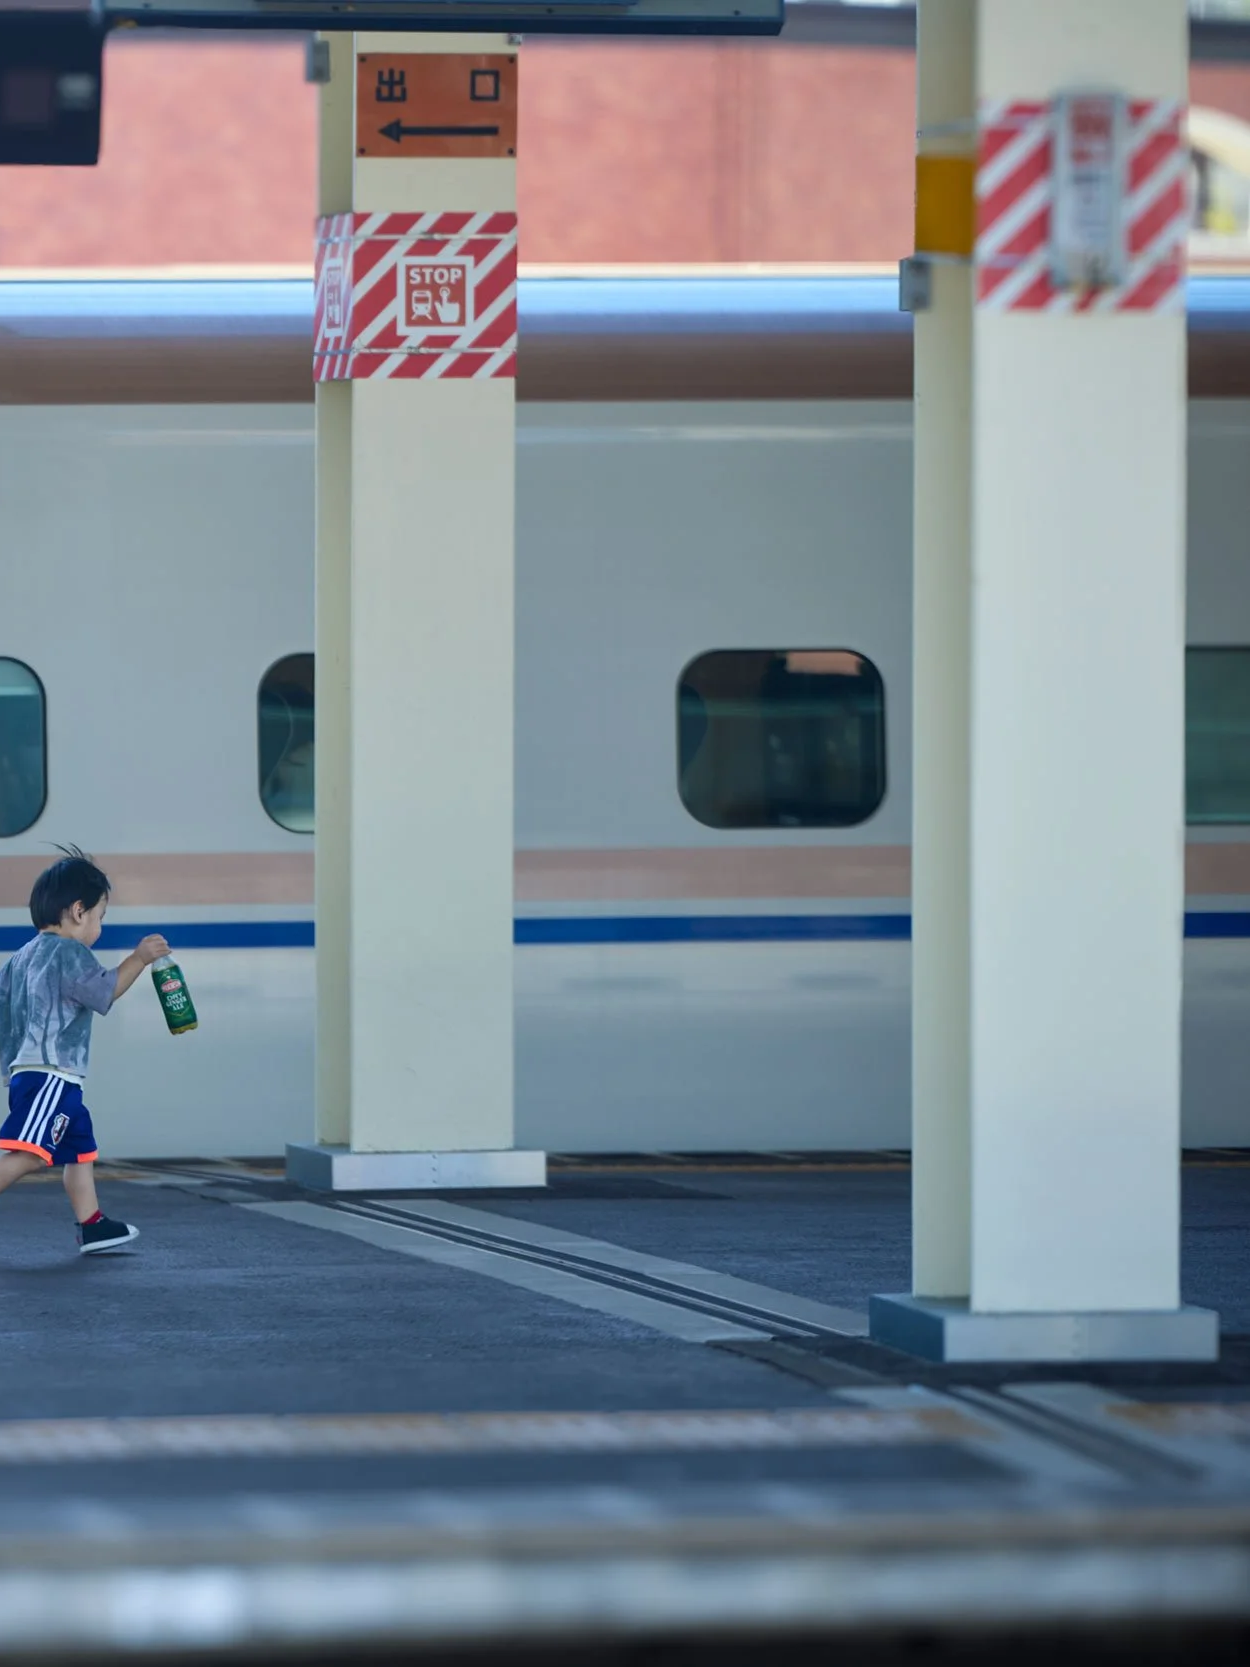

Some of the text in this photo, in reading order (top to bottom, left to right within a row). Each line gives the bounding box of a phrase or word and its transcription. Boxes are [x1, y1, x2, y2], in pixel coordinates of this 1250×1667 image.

[375, 68, 500, 103] 出口
[409, 267, 462, 285] STOP
[166, 991, 182, 1001] DRY
